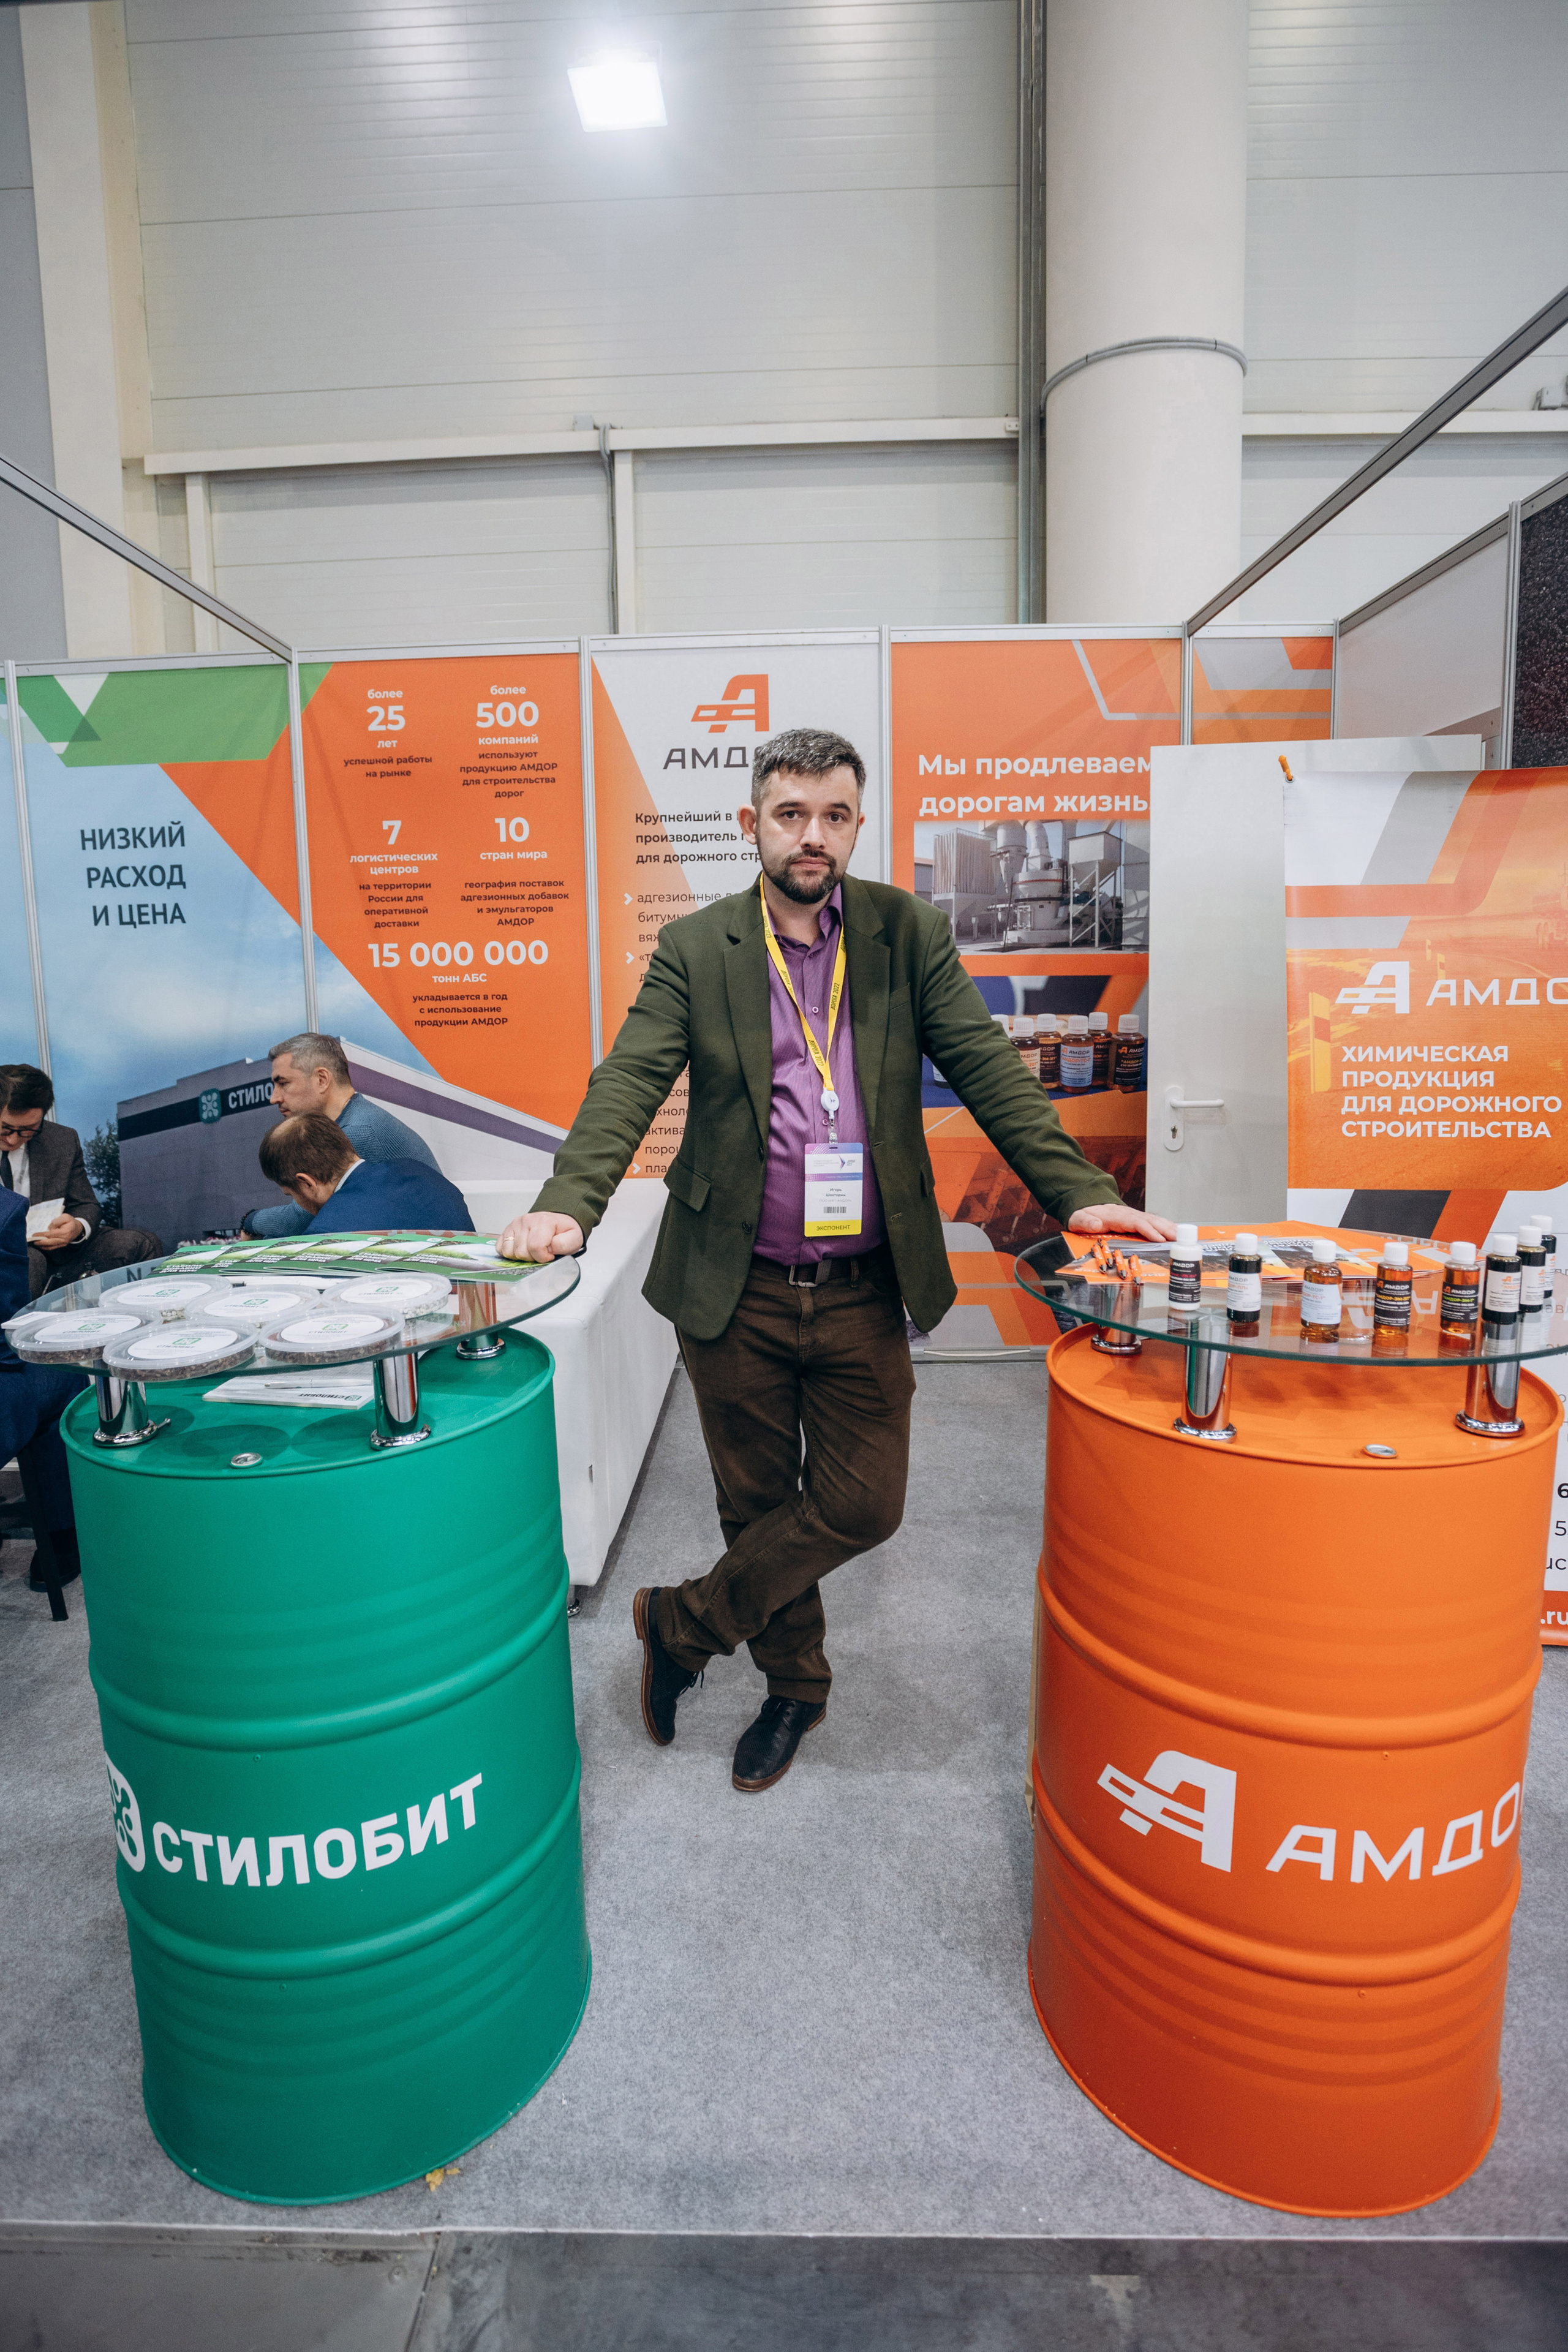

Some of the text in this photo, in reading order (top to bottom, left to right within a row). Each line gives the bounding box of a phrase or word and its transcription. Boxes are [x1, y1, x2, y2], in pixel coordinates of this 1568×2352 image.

[368, 689, 403, 699] более
[490, 685, 526, 695] более
[367, 706, 405, 731] 25
[476, 701, 539, 728] 500
[478, 734, 538, 745] компаний
[344, 755, 432, 767] успешной работы
[663, 747, 757, 769] АМД
[460, 763, 557, 774] продукцию АМДОР
[919, 755, 1150, 779] Мы продлеваем
[483, 777, 556, 786] строительства
[919, 796, 1044, 818] дорогам
[636, 811, 720, 825] Крупнейший
[80, 821, 185, 850] НИЗКИЙ
[383, 820, 401, 845] 7
[495, 817, 529, 842] 10
[636, 833, 737, 845] производитель
[350, 851, 437, 862] логистических
[480, 851, 547, 861] стран мира
[636, 852, 761, 864] для дорожного стр
[87, 864, 186, 889] РАСХОД
[370, 866, 418, 875] центров
[465, 880, 516, 889] география
[528, 892, 569, 900] добавок
[638, 893, 721, 903] адгезионные
[92, 903, 186, 929] И ЦЕНА
[364, 907, 428, 916] оперативной
[497, 918, 534, 927] АМДОР
[368, 940, 548, 967] 15 000 000
[463, 973, 486, 982] АБС
[415, 1017, 508, 1027] продукции АМДОР
[1342, 1046, 1508, 1061] ХИМИЧЕСКАЯ
[1343, 1071, 1494, 1090] ПРОДУКЦИЯ
[227, 1082, 274, 1109] СТИЛО
[1341, 1096, 1562, 1115] ДЛЯ ДОРОЖНОГО
[1342, 1121, 1551, 1137] СТРОИТЕЛЬСТВА
[153, 1773, 483, 1887] СТИЛОБИТ
[1265, 1782, 1521, 1883] АМДО
